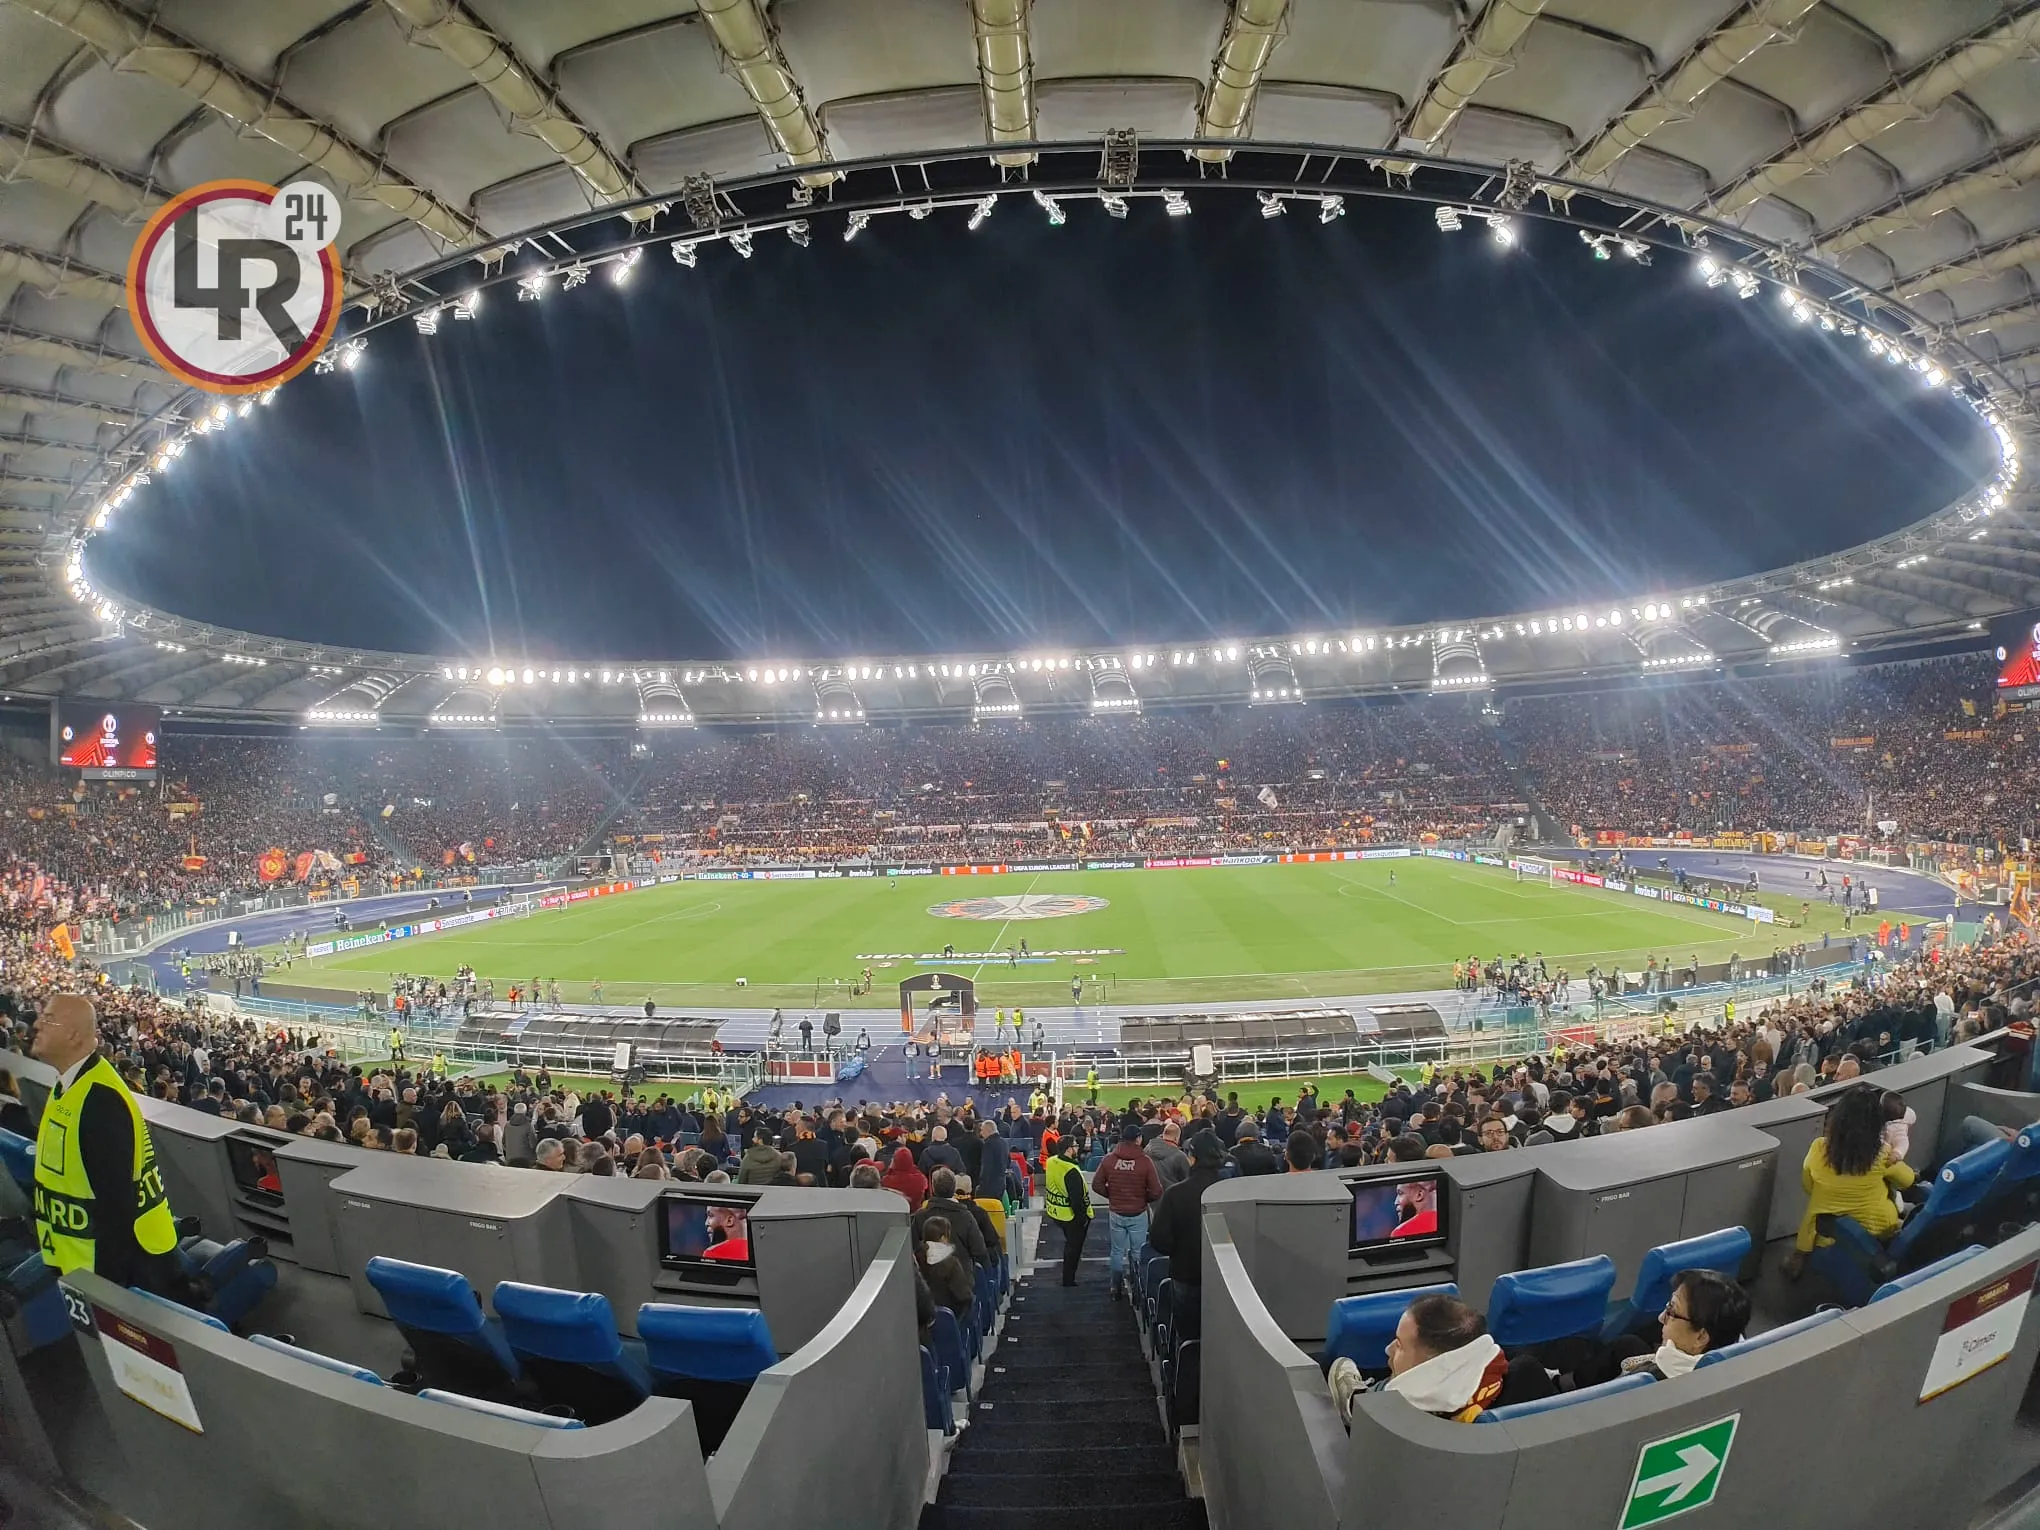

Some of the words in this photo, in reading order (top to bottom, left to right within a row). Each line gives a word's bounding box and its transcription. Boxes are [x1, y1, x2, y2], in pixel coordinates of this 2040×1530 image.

[102, 770, 137, 778] OLIMPICO
[1364, 850, 1400, 858] Swissquote
[1087, 861, 1135, 870] enterprise
[698, 872, 732, 880] Heineken
[887, 867, 933, 876] enterprise
[1673, 894, 1686, 903] UEFA
[336, 934, 384, 951] Heineken
[1114, 1159, 1135, 1171] ASR
[1601, 1194, 1618, 1202] FRIGO
[64, 1295, 90, 1326] 23
